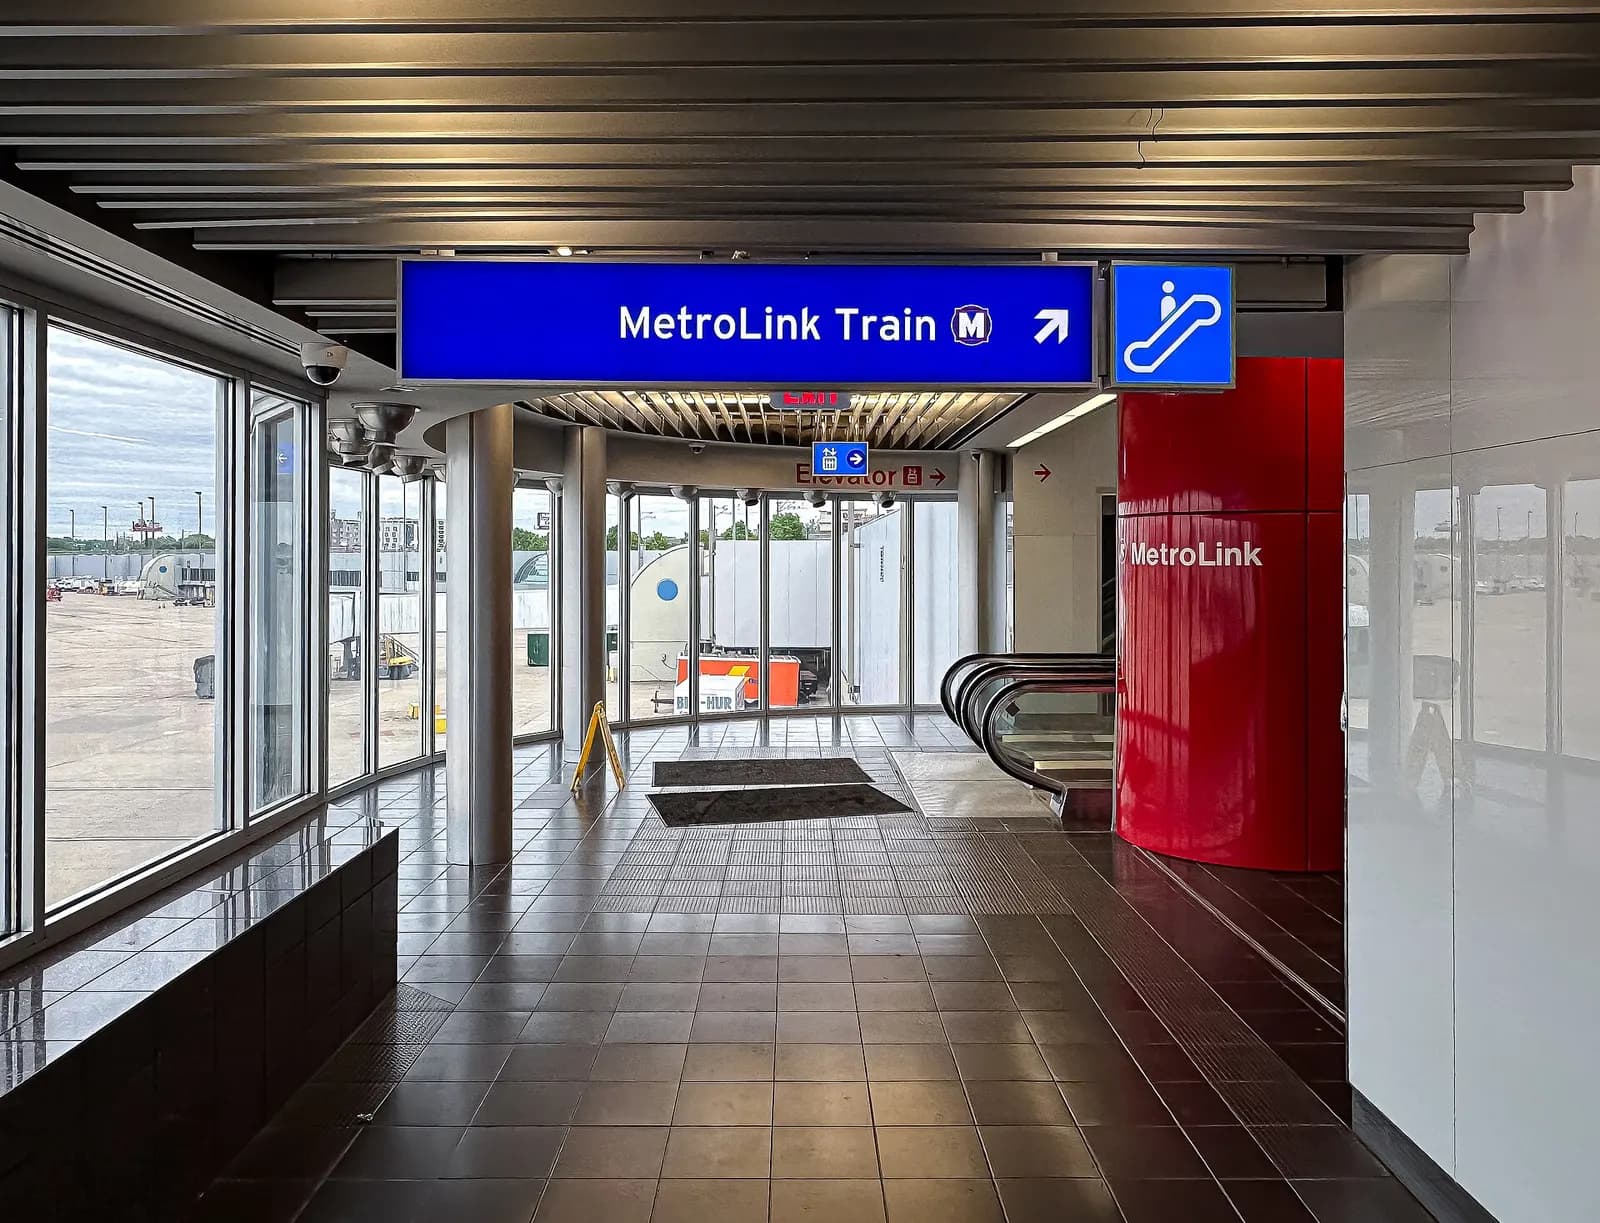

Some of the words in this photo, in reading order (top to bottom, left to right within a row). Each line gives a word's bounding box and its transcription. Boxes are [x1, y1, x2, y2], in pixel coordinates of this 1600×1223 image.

[620, 305, 821, 340] MetroLink
[835, 307, 936, 341] Train
[1131, 541, 1263, 567] MetroLink
